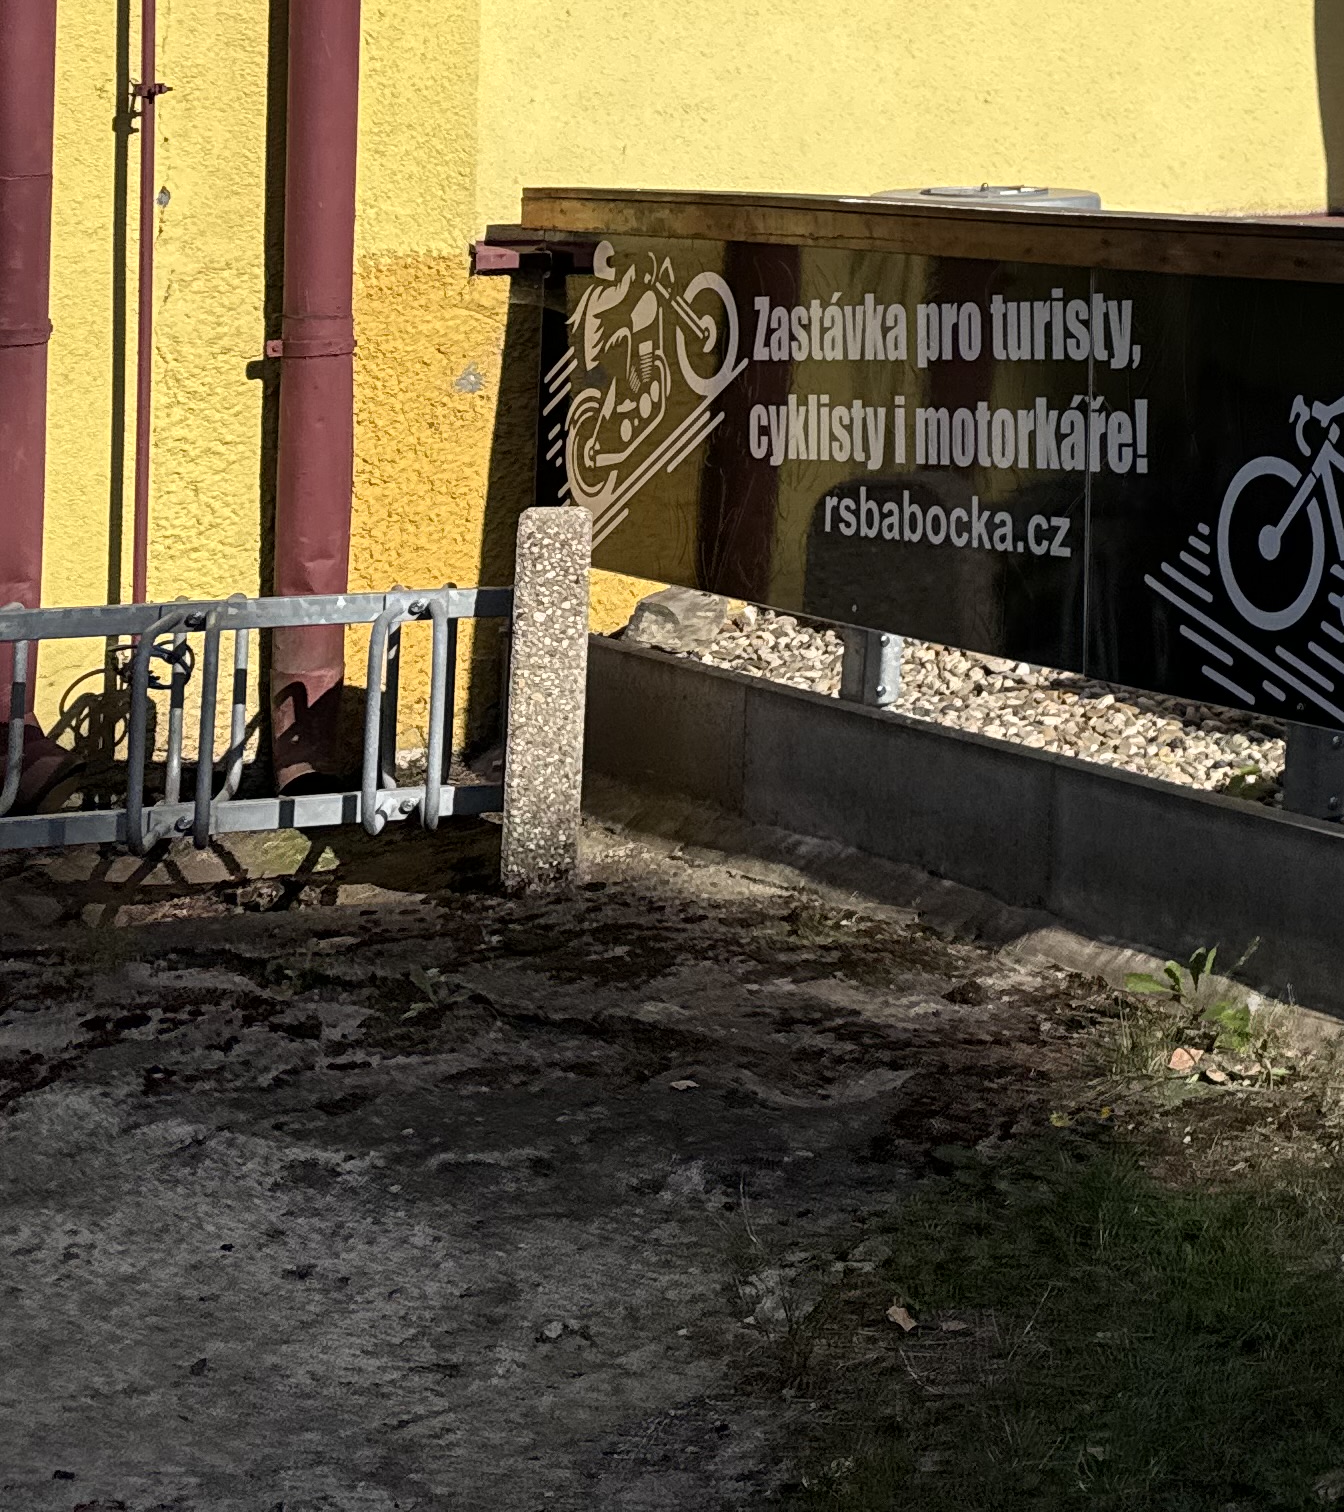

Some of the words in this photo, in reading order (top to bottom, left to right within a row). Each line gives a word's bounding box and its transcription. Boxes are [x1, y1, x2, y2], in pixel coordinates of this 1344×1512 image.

[752, 291, 908, 362] Zastávka
[916, 300, 982, 369] pro
[991, 288, 1142, 370] turisty,
[748, 394, 887, 470] cyklisty
[895, 395, 907, 463] i
[916, 394, 1149, 474] motorkáře!
[824, 486, 1072, 558] rsbabocka.cz
